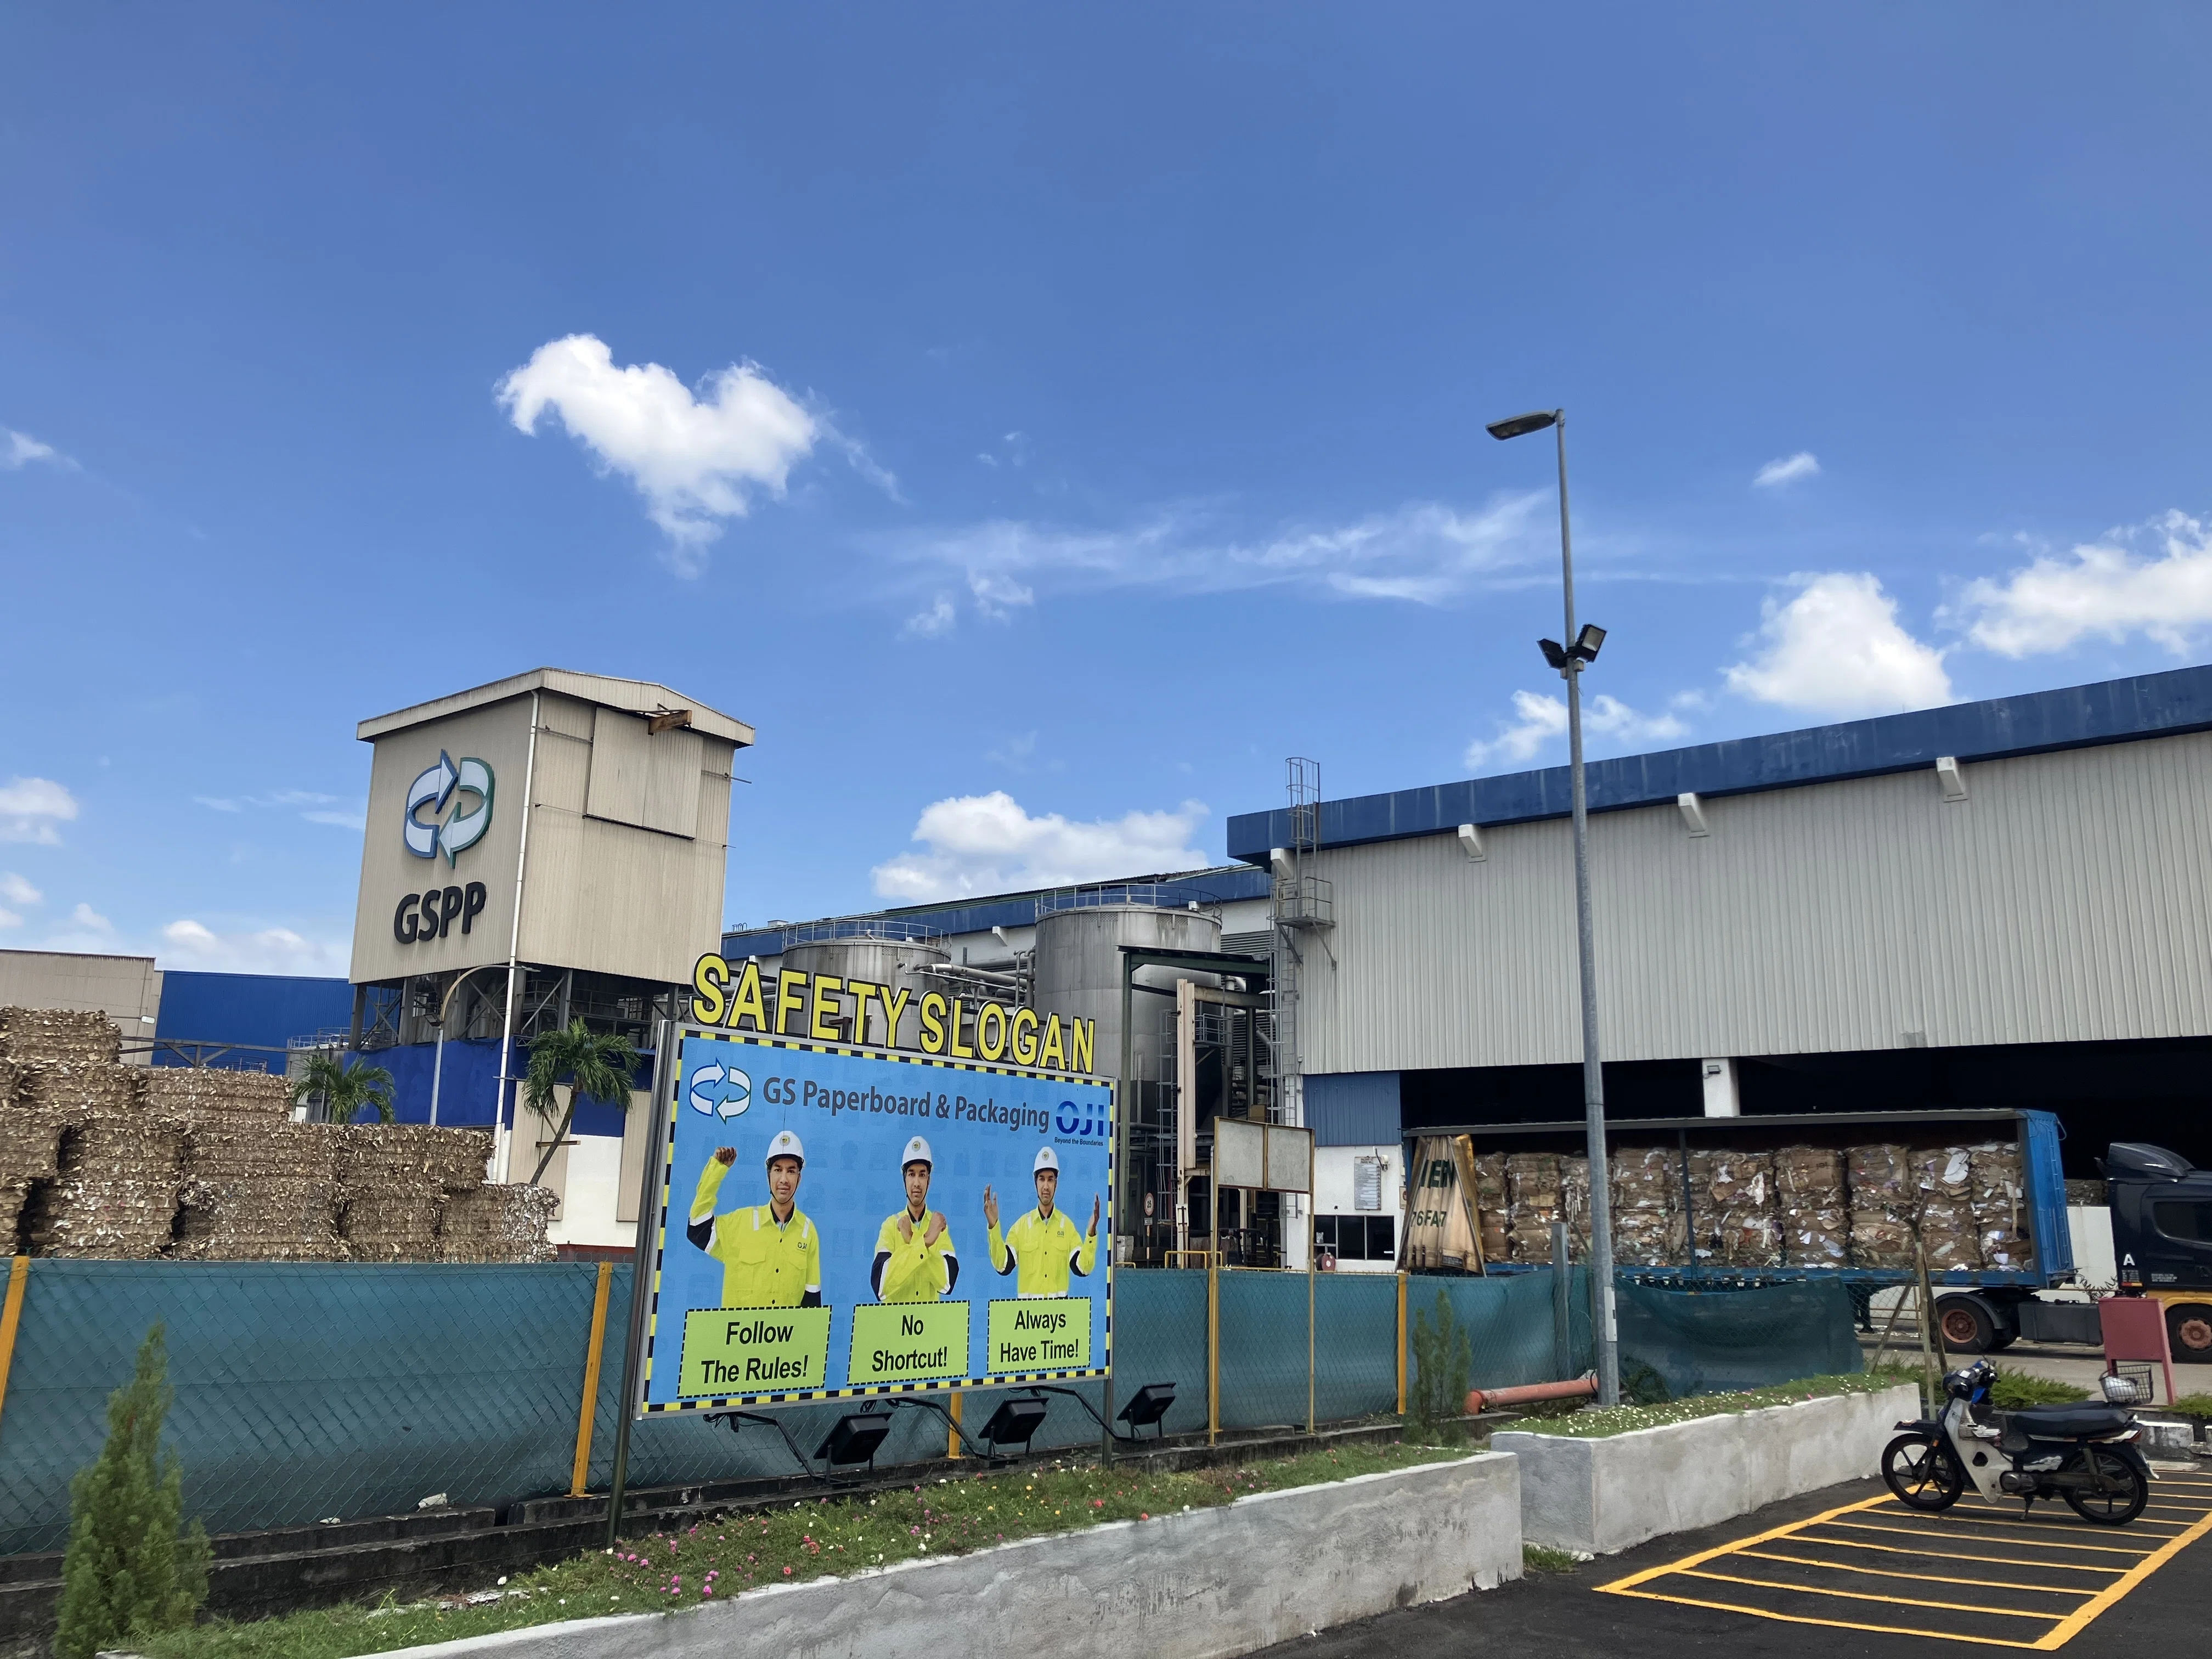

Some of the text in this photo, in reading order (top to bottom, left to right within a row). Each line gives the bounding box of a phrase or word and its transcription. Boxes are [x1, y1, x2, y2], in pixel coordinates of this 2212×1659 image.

[394, 881, 487, 944] GSPP
[691, 953, 1096, 1074] SAFETY SLOGAN
[763, 1077, 1049, 1134] GS Paperboard & Packaging
[1056, 1101, 1104, 1137] OJI
[1054, 1137, 1071, 1145] Beyond
[2123, 1253, 2136, 1266] A
[726, 1321, 794, 1345] Follow
[901, 1314, 924, 1336] No
[1014, 1310, 1066, 1334] Always
[872, 1346, 947, 1372] Shortcut!
[1000, 1339, 1079, 1363] Have Time!
[701, 1355, 809, 1384] The Rules!
